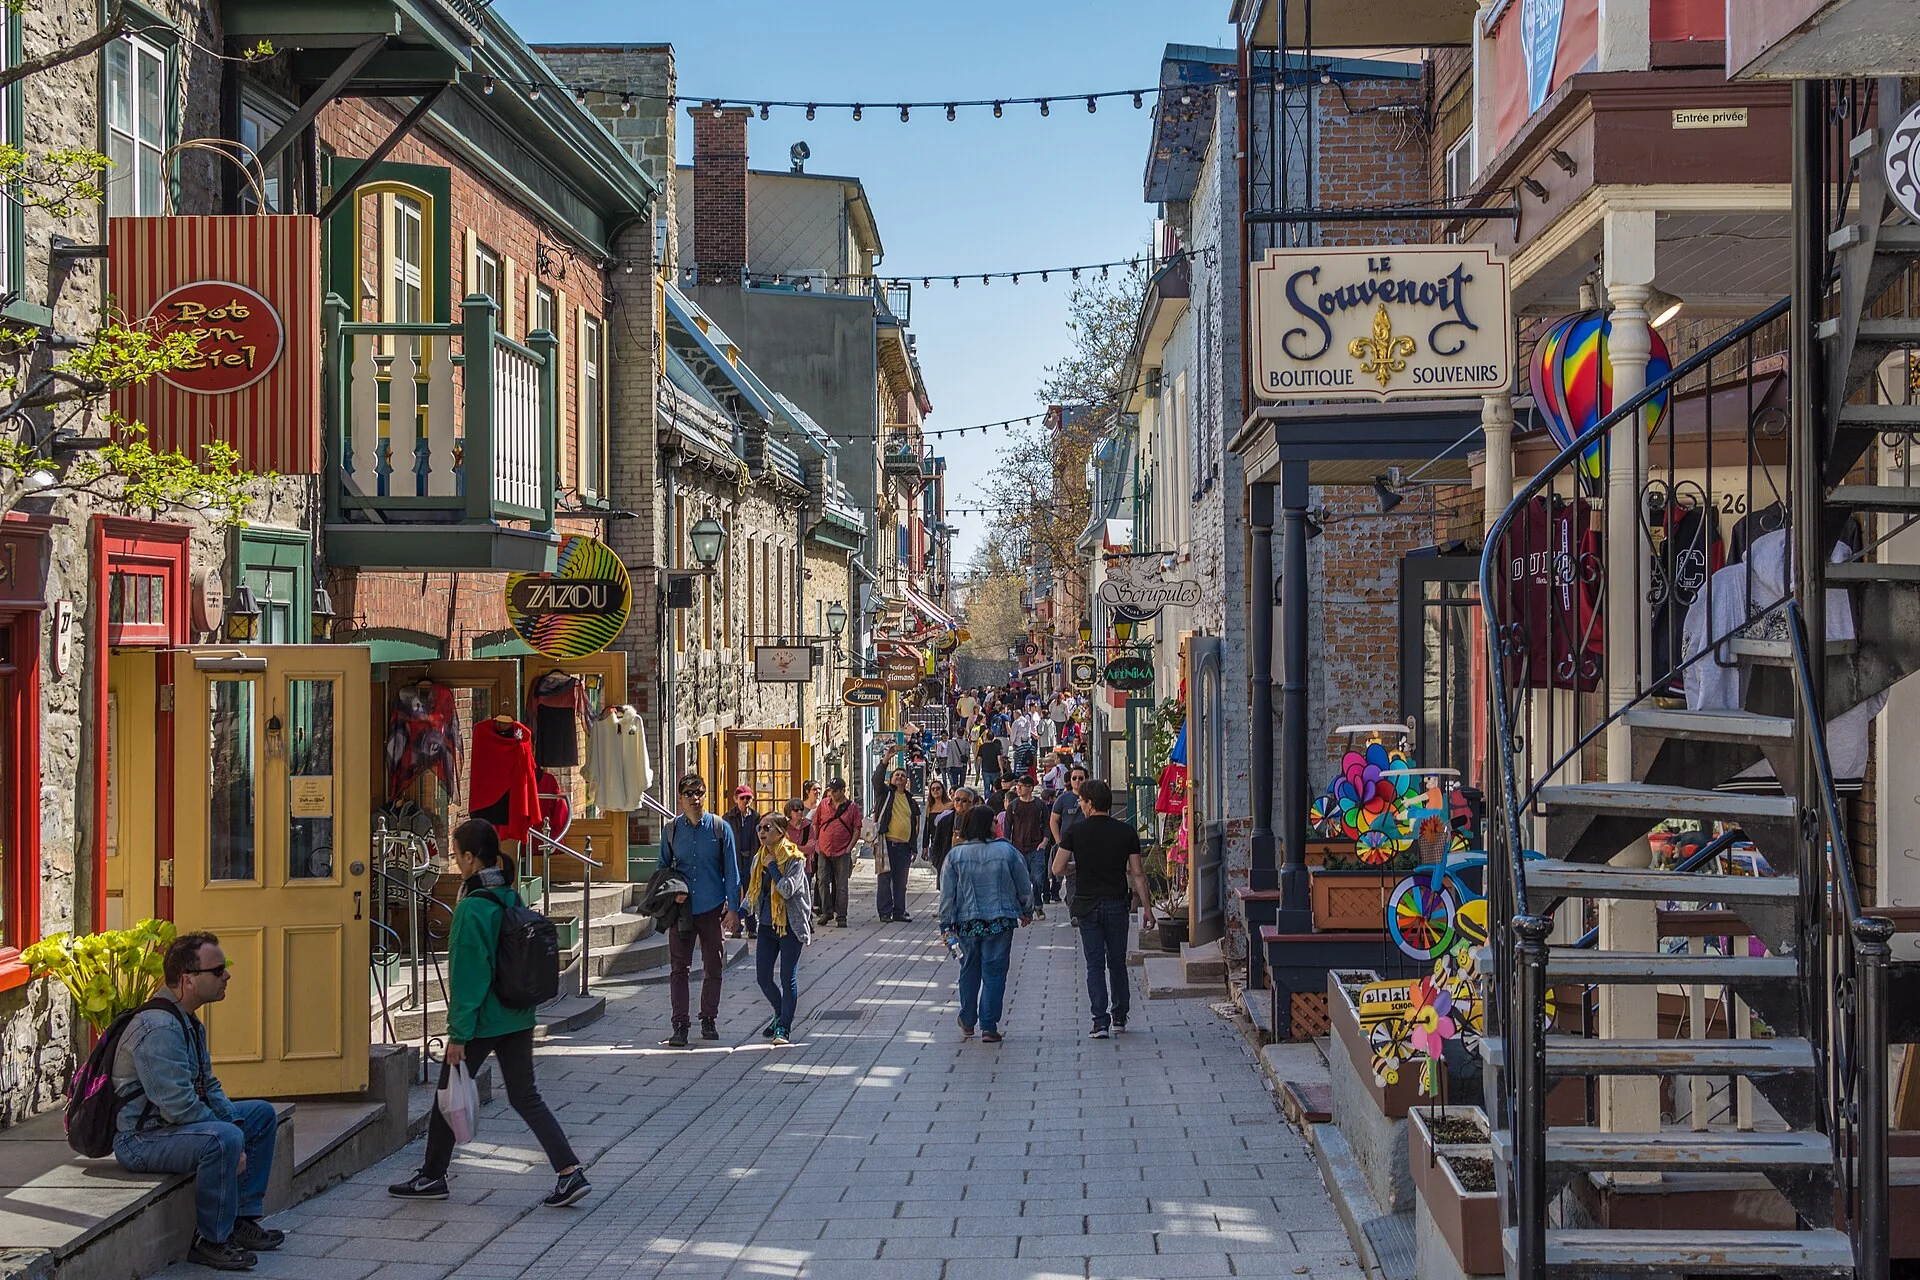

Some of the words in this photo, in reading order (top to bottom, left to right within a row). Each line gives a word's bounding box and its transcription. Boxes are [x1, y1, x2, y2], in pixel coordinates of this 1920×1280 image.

[1676, 112, 1709, 123] Entrée
[1712, 111, 1744, 124] privée
[1367, 256, 1391, 272] LE
[173, 299, 251, 322] Pot
[189, 327, 245, 341] en
[1270, 369, 1354, 387] BOUTIQUE
[1413, 365, 1498, 384] SOUVENIRS
[1721, 493, 1747, 515] 26
[526, 585, 607, 609] ZAZOU
[1102, 582, 1198, 609] Scrupules
[1391, 1002, 1414, 1010] SCHOO
